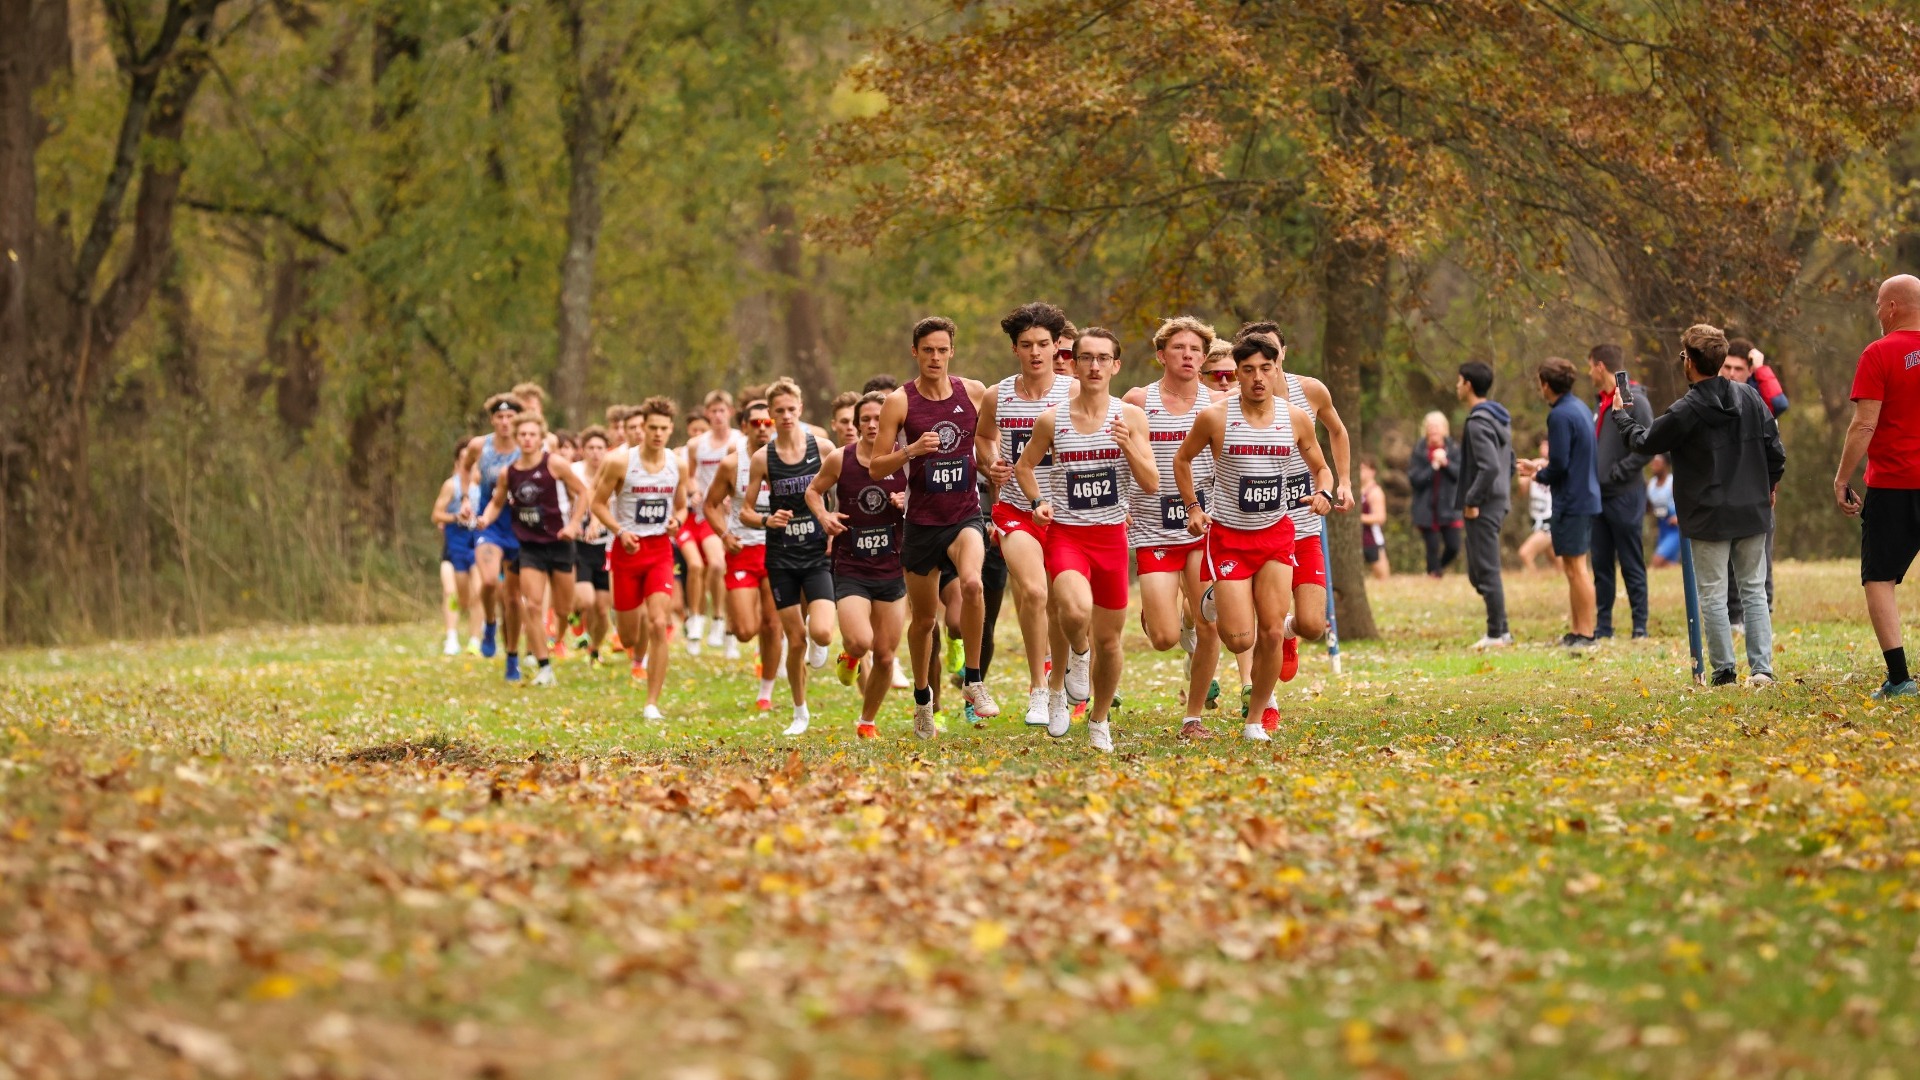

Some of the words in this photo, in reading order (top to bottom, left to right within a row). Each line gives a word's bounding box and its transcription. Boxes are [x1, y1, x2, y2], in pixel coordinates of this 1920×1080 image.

[932, 467, 963, 484] 4617
[1073, 480, 1112, 498] 4662
[1244, 486, 1278, 503] 4659
[785, 520, 815, 536] 4609
[857, 534, 889, 549] 4623
